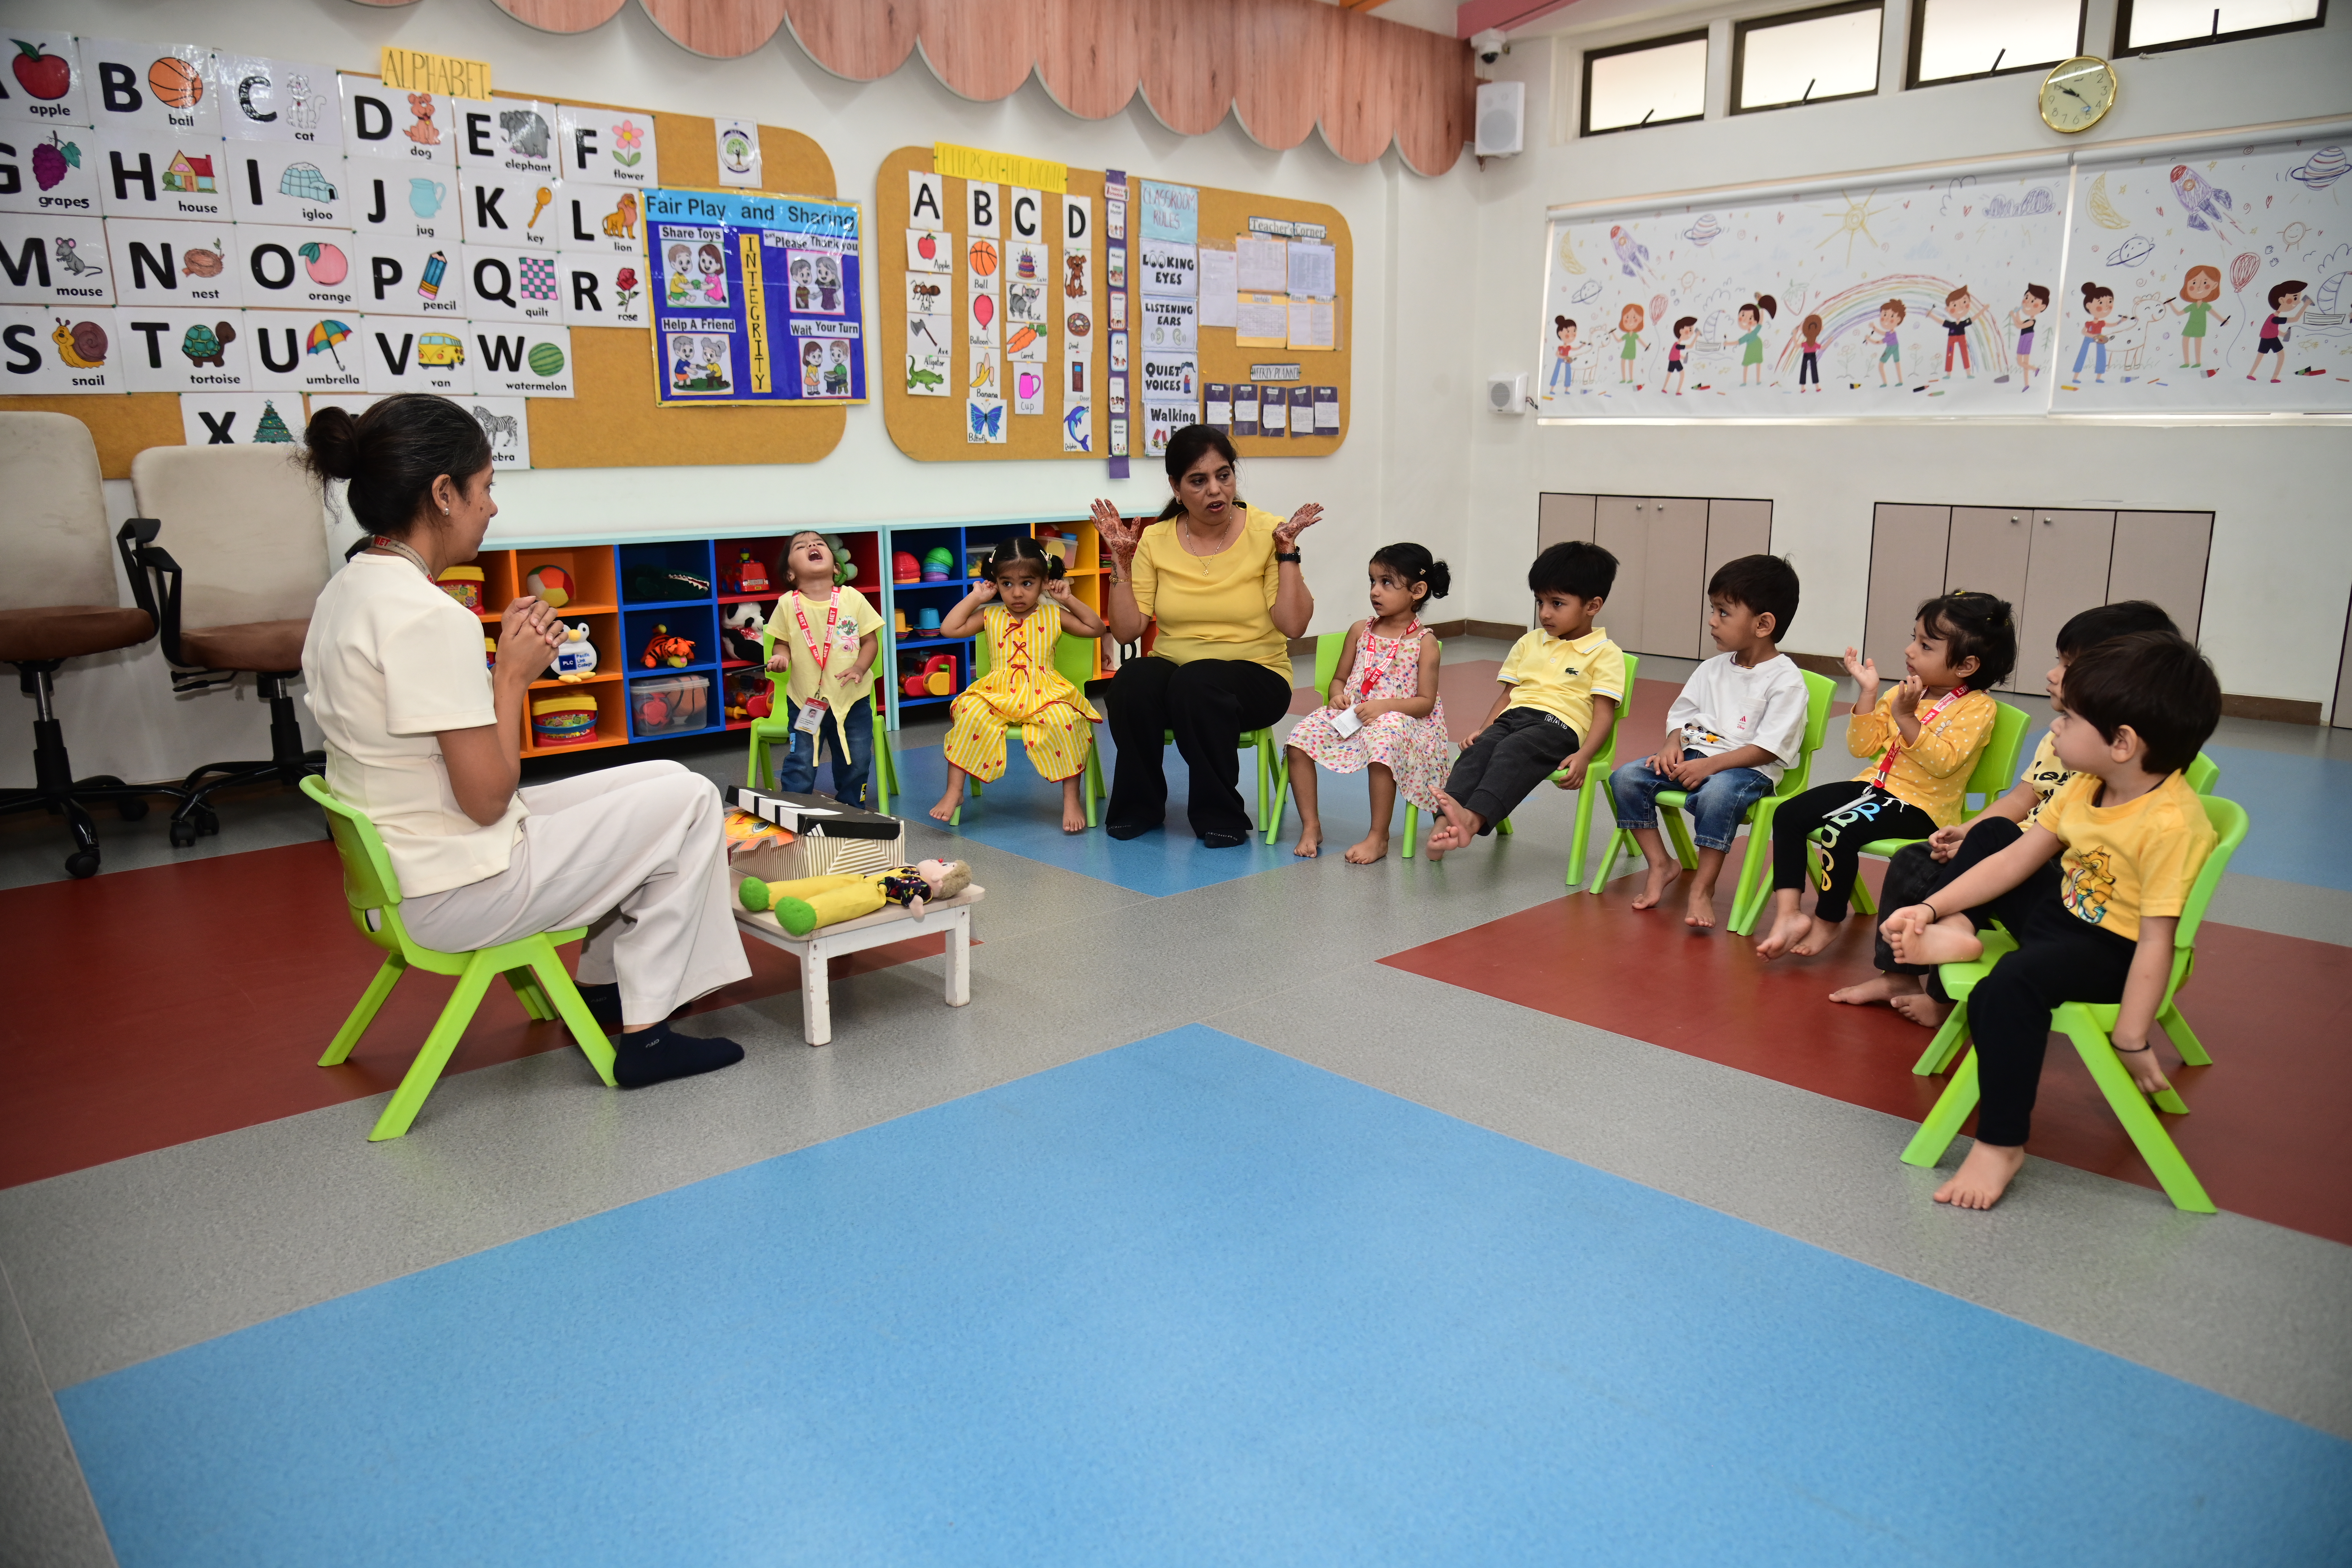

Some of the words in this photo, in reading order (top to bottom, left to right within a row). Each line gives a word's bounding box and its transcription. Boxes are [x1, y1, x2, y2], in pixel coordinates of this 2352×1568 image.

[385, 49, 487, 100] ALPHABET
[2097, 74, 2103, 83] 2
[99, 62, 142, 112] B
[2101, 86, 2107, 96] 3
[239, 76, 278, 122] C
[2049, 96, 2055, 104] 9
[2096, 100, 2101, 109] 4
[30, 104, 70, 117] apple
[2052, 108, 2058, 117] 8
[354, 95, 392, 141] D
[2063, 114, 2067, 123] 7
[2073, 115, 2079, 125] 6
[295, 132, 315, 142] cat
[466, 112, 494, 157] E
[411, 146, 432, 160] dog
[575, 129, 598, 169] F
[505, 160, 552, 173] elephant
[936, 146, 983, 177] LETTERS
[109, 151, 156, 201] H
[614, 169, 644, 181] flower
[247, 159, 263, 205] I
[39, 196, 89, 209] grapes
[368, 180, 386, 223] J
[914, 183, 940, 219] A
[1143, 187, 1195, 213] CLASSROOM
[179, 201, 218, 213] house
[475, 186, 508, 229] K
[647, 196, 682, 214] Fair
[689, 198, 726, 220] Play
[741, 205, 775, 221] and
[788, 206, 855, 231] Sharing
[974, 190, 992, 226] B
[302, 209, 333, 221] igloo
[572, 200, 594, 241] L
[1015, 197, 1035, 236] C
[1069, 204, 1086, 238] D
[1154, 210, 1180, 229] RULES
[417, 224, 434, 237] jug
[663, 227, 695, 239] Share
[697, 227, 721, 240] Toys
[1251, 219, 1294, 236] Teacher's
[1296, 224, 1323, 237] Corner
[527, 233, 544, 244] key
[776, 237, 807, 248] Please
[811, 236, 838, 249] Thank
[842, 242, 858, 251] you
[614, 242, 632, 252] lion
[0, 237, 51, 288] M
[129, 242, 177, 289] N
[251, 243, 295, 289] O
[934, 259, 950, 270] Apple
[371, 257, 403, 300] P
[473, 258, 516, 308] Q
[974, 280, 988, 289] Ball
[1155, 272, 1182, 285] EYES
[56, 286, 103, 297] mouse
[192, 289, 219, 299] nest
[308, 292, 351, 303] orange
[572, 271, 602, 311] R
[423, 300, 455, 311] pencil
[526, 307, 548, 317] quilt
[920, 303, 931, 312] Ant
[1145, 303, 1193, 315] LISTENING
[618, 313, 638, 321] rose
[746, 236, 765, 390] INTEGRITY
[663, 319, 687, 331] Help
[690, 319, 697, 330] A
[701, 319, 734, 330] Friend
[1157, 317, 1181, 326] EARS
[791, 324, 812, 336] Wait
[816, 322, 836, 333] Your
[839, 323, 858, 334] Turn
[131, 322, 169, 368] T
[970, 337, 988, 345] Balloon
[3, 324, 42, 374] S
[258, 328, 299, 373] U
[375, 333, 413, 376] V
[477, 334, 525, 372] W
[924, 357, 944, 367] Alligator
[1146, 362, 1181, 378] QUIET
[1252, 368, 1274, 379] WEEKLY
[1274, 368, 1299, 379] PLANNER
[73, 375, 104, 386] snail
[190, 374, 240, 384] tortoise
[306, 375, 359, 385] umbrella
[1145, 380, 1181, 391] VOICES
[506, 382, 567, 391] watermelon
[977, 390, 998, 398] Banana
[1021, 403, 1034, 411] Cup
[1151, 408, 1196, 426] Walking
[198, 412, 236, 444] X
[969, 433, 987, 442] Butterfly
[492, 452, 515, 461] ebra
[1379, 660, 1388, 669] Bhujbal
[1370, 671, 1380, 683] MET
[1956, 685, 1969, 695] MET
[1938, 696, 1955, 710] Bhujbal
[1921, 712, 1935, 724] MET
[1821, 803, 1880, 891] dance
